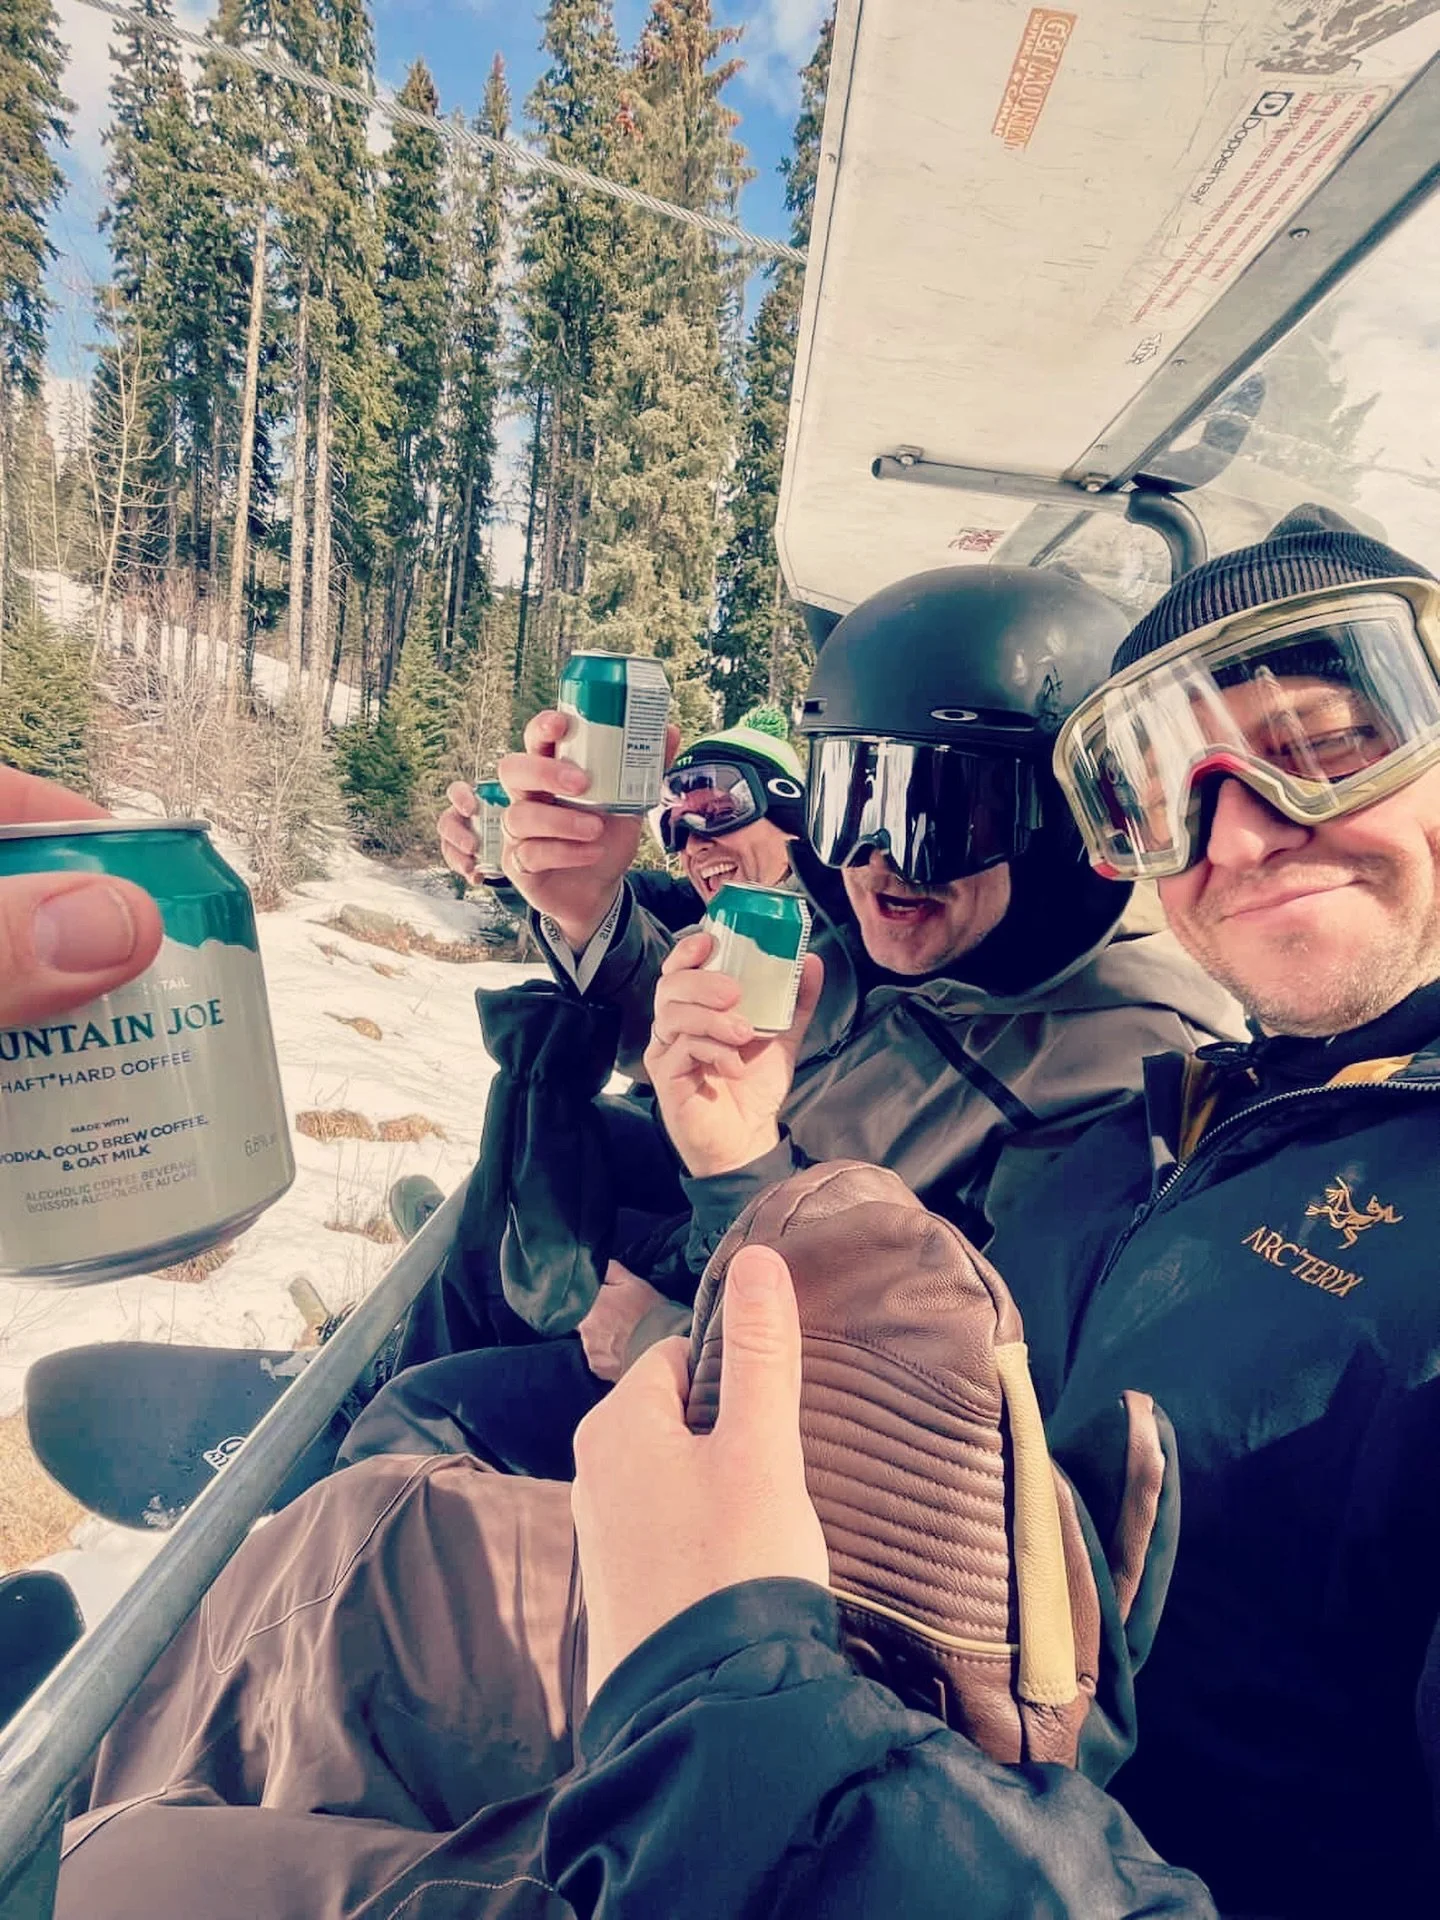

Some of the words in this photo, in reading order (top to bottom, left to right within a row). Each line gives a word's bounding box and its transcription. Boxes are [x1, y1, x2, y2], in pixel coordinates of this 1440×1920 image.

[1191, 116, 1262, 203] Doppelmayr
[167, 999, 225, 1035] JOE
[59, 1066, 116, 1087] HARD
[122, 1050, 192, 1076] COFFEE
[102, 1116, 129, 1128] WITH
[54, 1141, 98, 1158] COLD
[103, 1129, 148, 1149] BREW
[62, 1160, 74, 1172] &
[77, 1153, 108, 1169] OAT
[112, 1144, 151, 1162] MILK
[1241, 1225, 1364, 1298] ARC'TERYX
